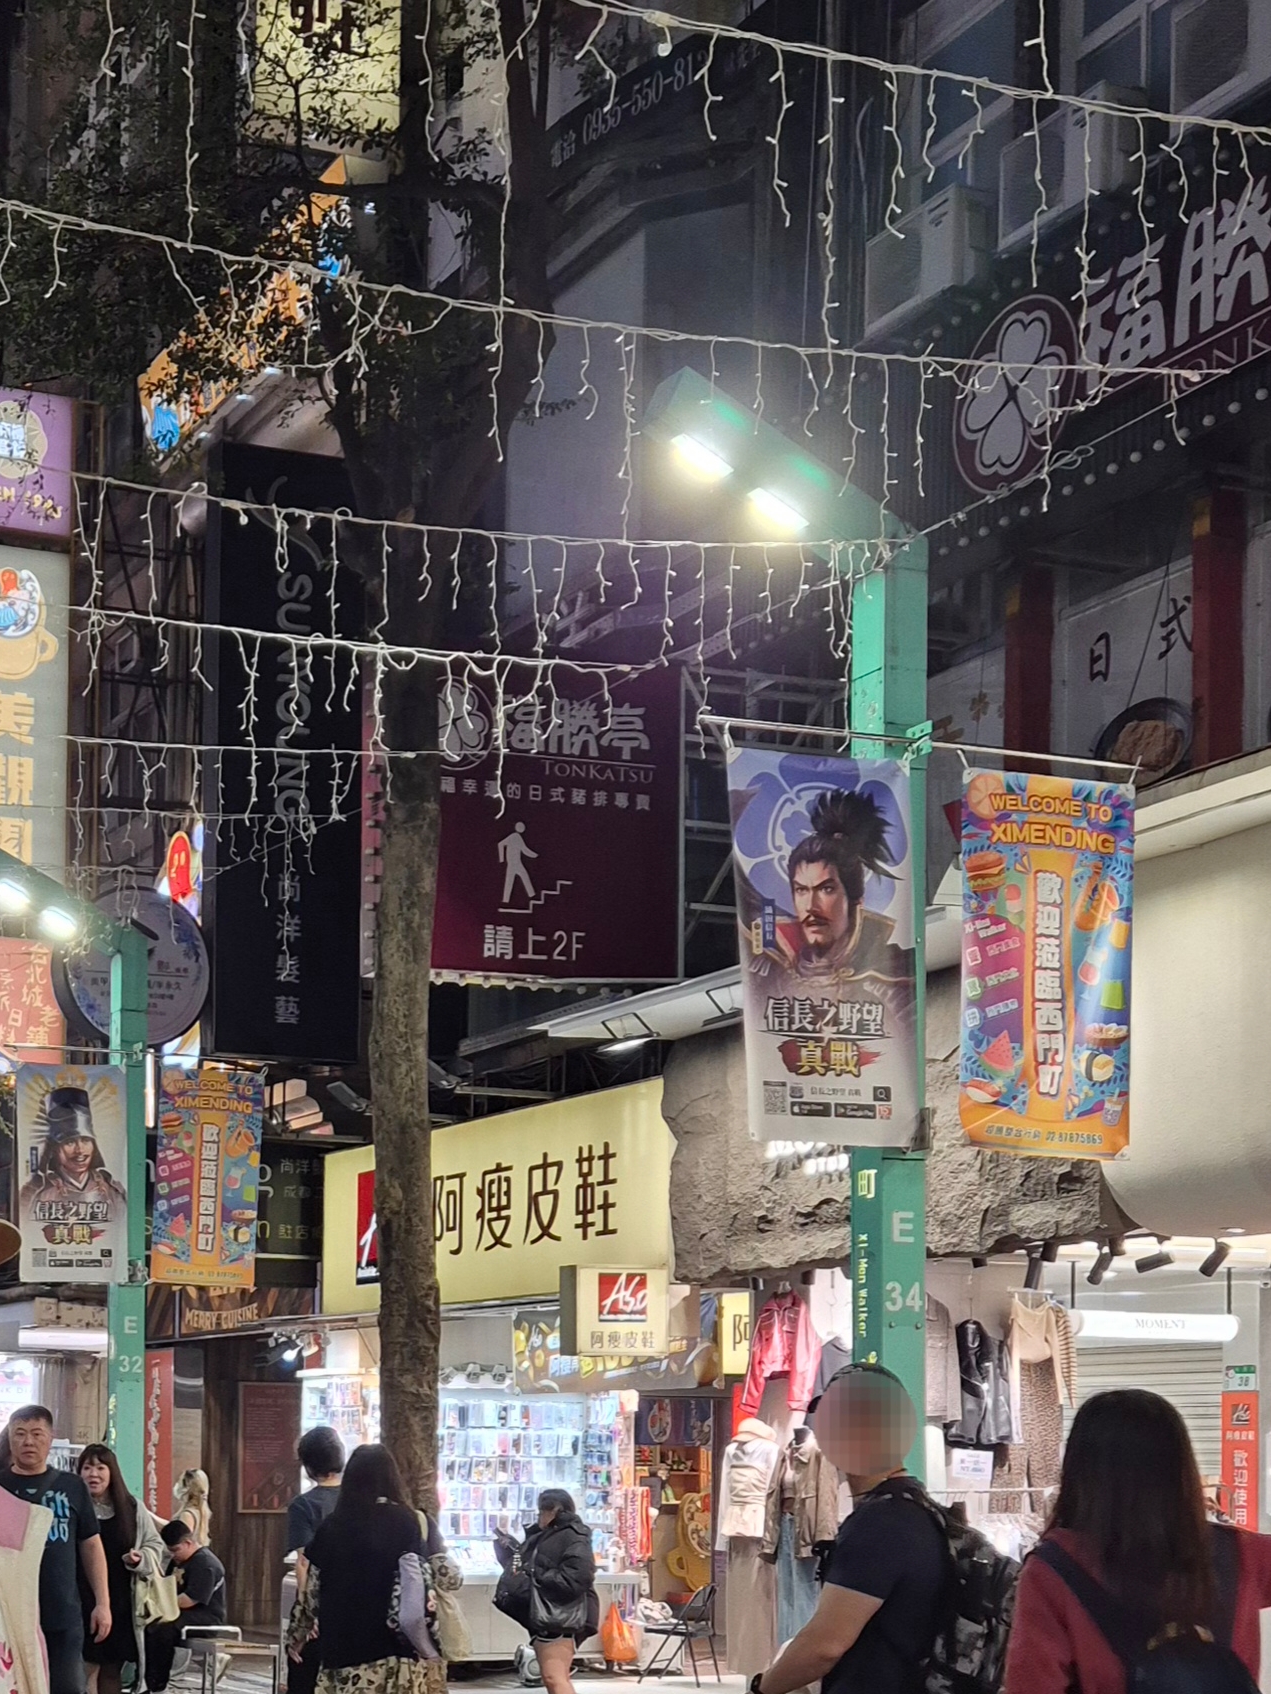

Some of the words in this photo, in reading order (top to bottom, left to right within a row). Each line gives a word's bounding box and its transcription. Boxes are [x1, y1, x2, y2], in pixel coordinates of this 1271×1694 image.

[494, 694, 651, 760] 福勝亭
[541, 760, 653, 783] TONKATSU
[990, 794, 1082, 817] WELCOME
[1087, 803, 1113, 822] TO
[990, 822, 1116, 855] XIMENDING
[483, 923, 587, 963] 請上2F
[1034, 871, 1064, 1096] 歡迎蒞臨西門町
[765, 997, 884, 1036] 信長之野望
[797, 1041, 860, 1077] 真戰
[175, 1078, 234, 1093] WELCOME
[237, 1083, 265, 1096] TO
[175, 1095, 264, 1114] XIMENDING
[34, 1200, 107, 1221] 信長之野望
[434, 1141, 619, 1256] 阿瘦皮鞋
[50, 1222, 94, 1246] 真戰
[891, 1210, 916, 1244] E
[884, 1280, 924, 1313] 34
[123, 1315, 139, 1335] E
[185, 1308, 218, 1331] MERRY
[1135, 1318, 1188, 1330] MOMENT
[590, 1329, 656, 1350] 阿瘦皮鞋
[118, 1355, 144, 1374] 32
[1232, 1449, 1249, 1526] 歡迎使用
